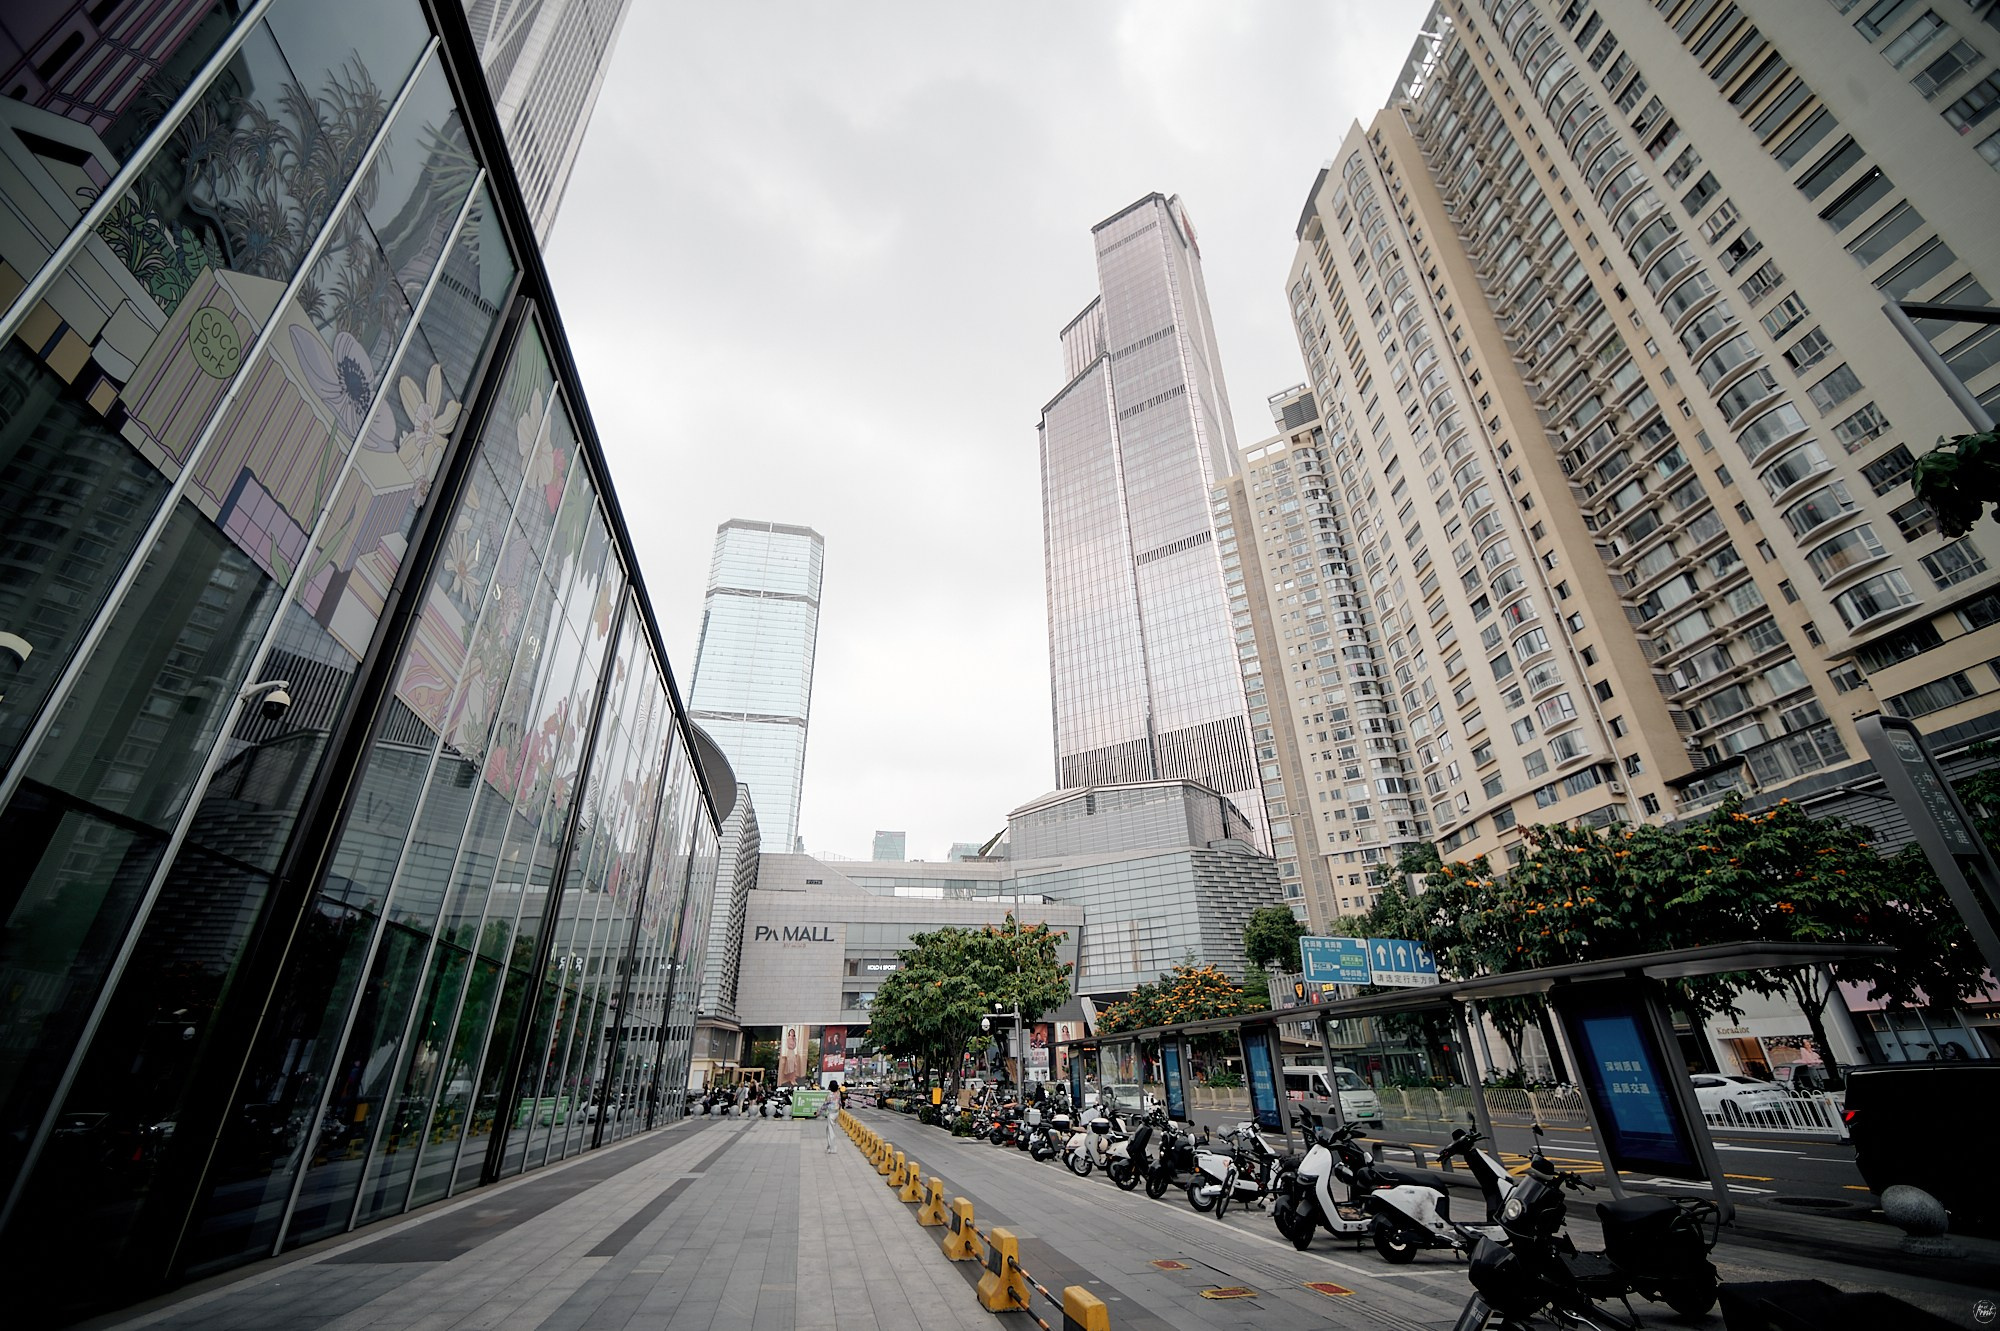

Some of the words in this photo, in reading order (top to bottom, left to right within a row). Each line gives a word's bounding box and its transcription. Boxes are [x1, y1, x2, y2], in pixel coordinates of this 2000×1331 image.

[201, 312, 239, 361] COCO
[194, 328, 225, 375] Park
[783, 926, 834, 942] MALL
[1376, 974, 1436, 985] 请选定行车方向
[1604, 1061, 1642, 1071] 深圳质量
[1612, 1083, 1650, 1094] 品质交通
